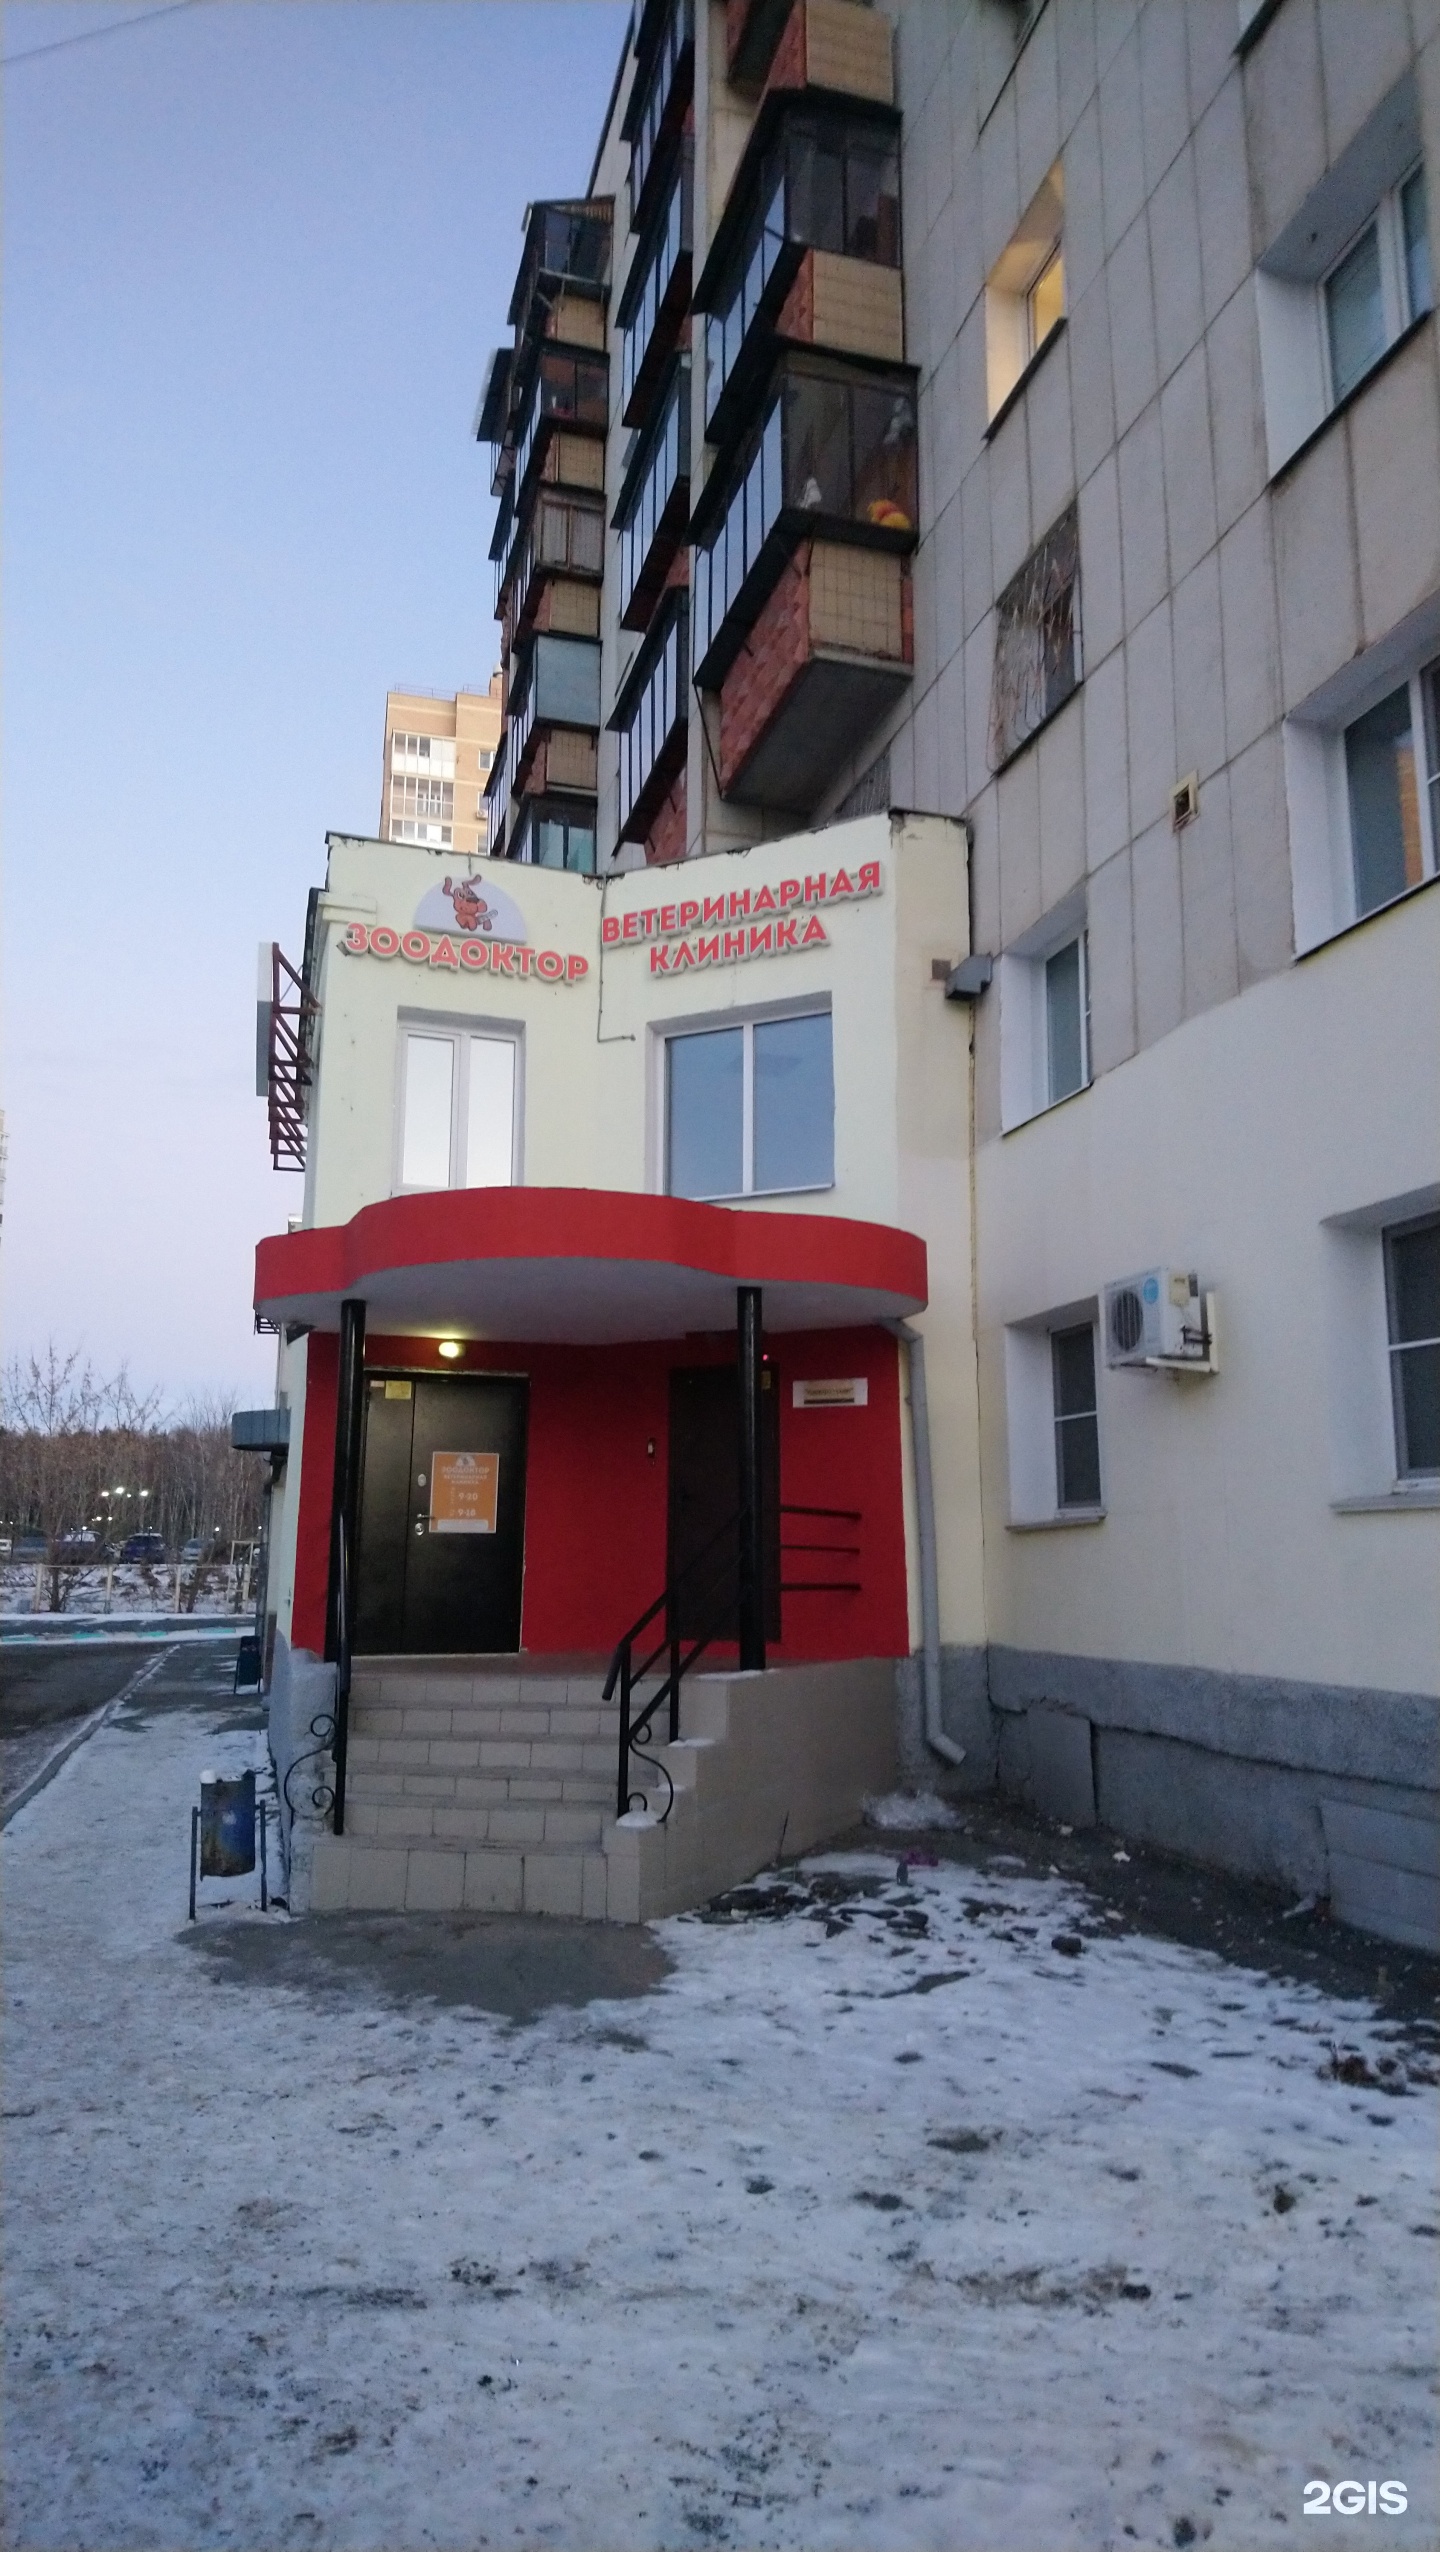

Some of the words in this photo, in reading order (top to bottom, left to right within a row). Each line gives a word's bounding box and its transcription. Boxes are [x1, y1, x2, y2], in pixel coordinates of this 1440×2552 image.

[602, 861, 881, 944] ВЕТЕРИНАРНАЯ
[346, 923, 589, 986] ЗООДОКТОР
[650, 915, 827, 974] КЛИНИКА
